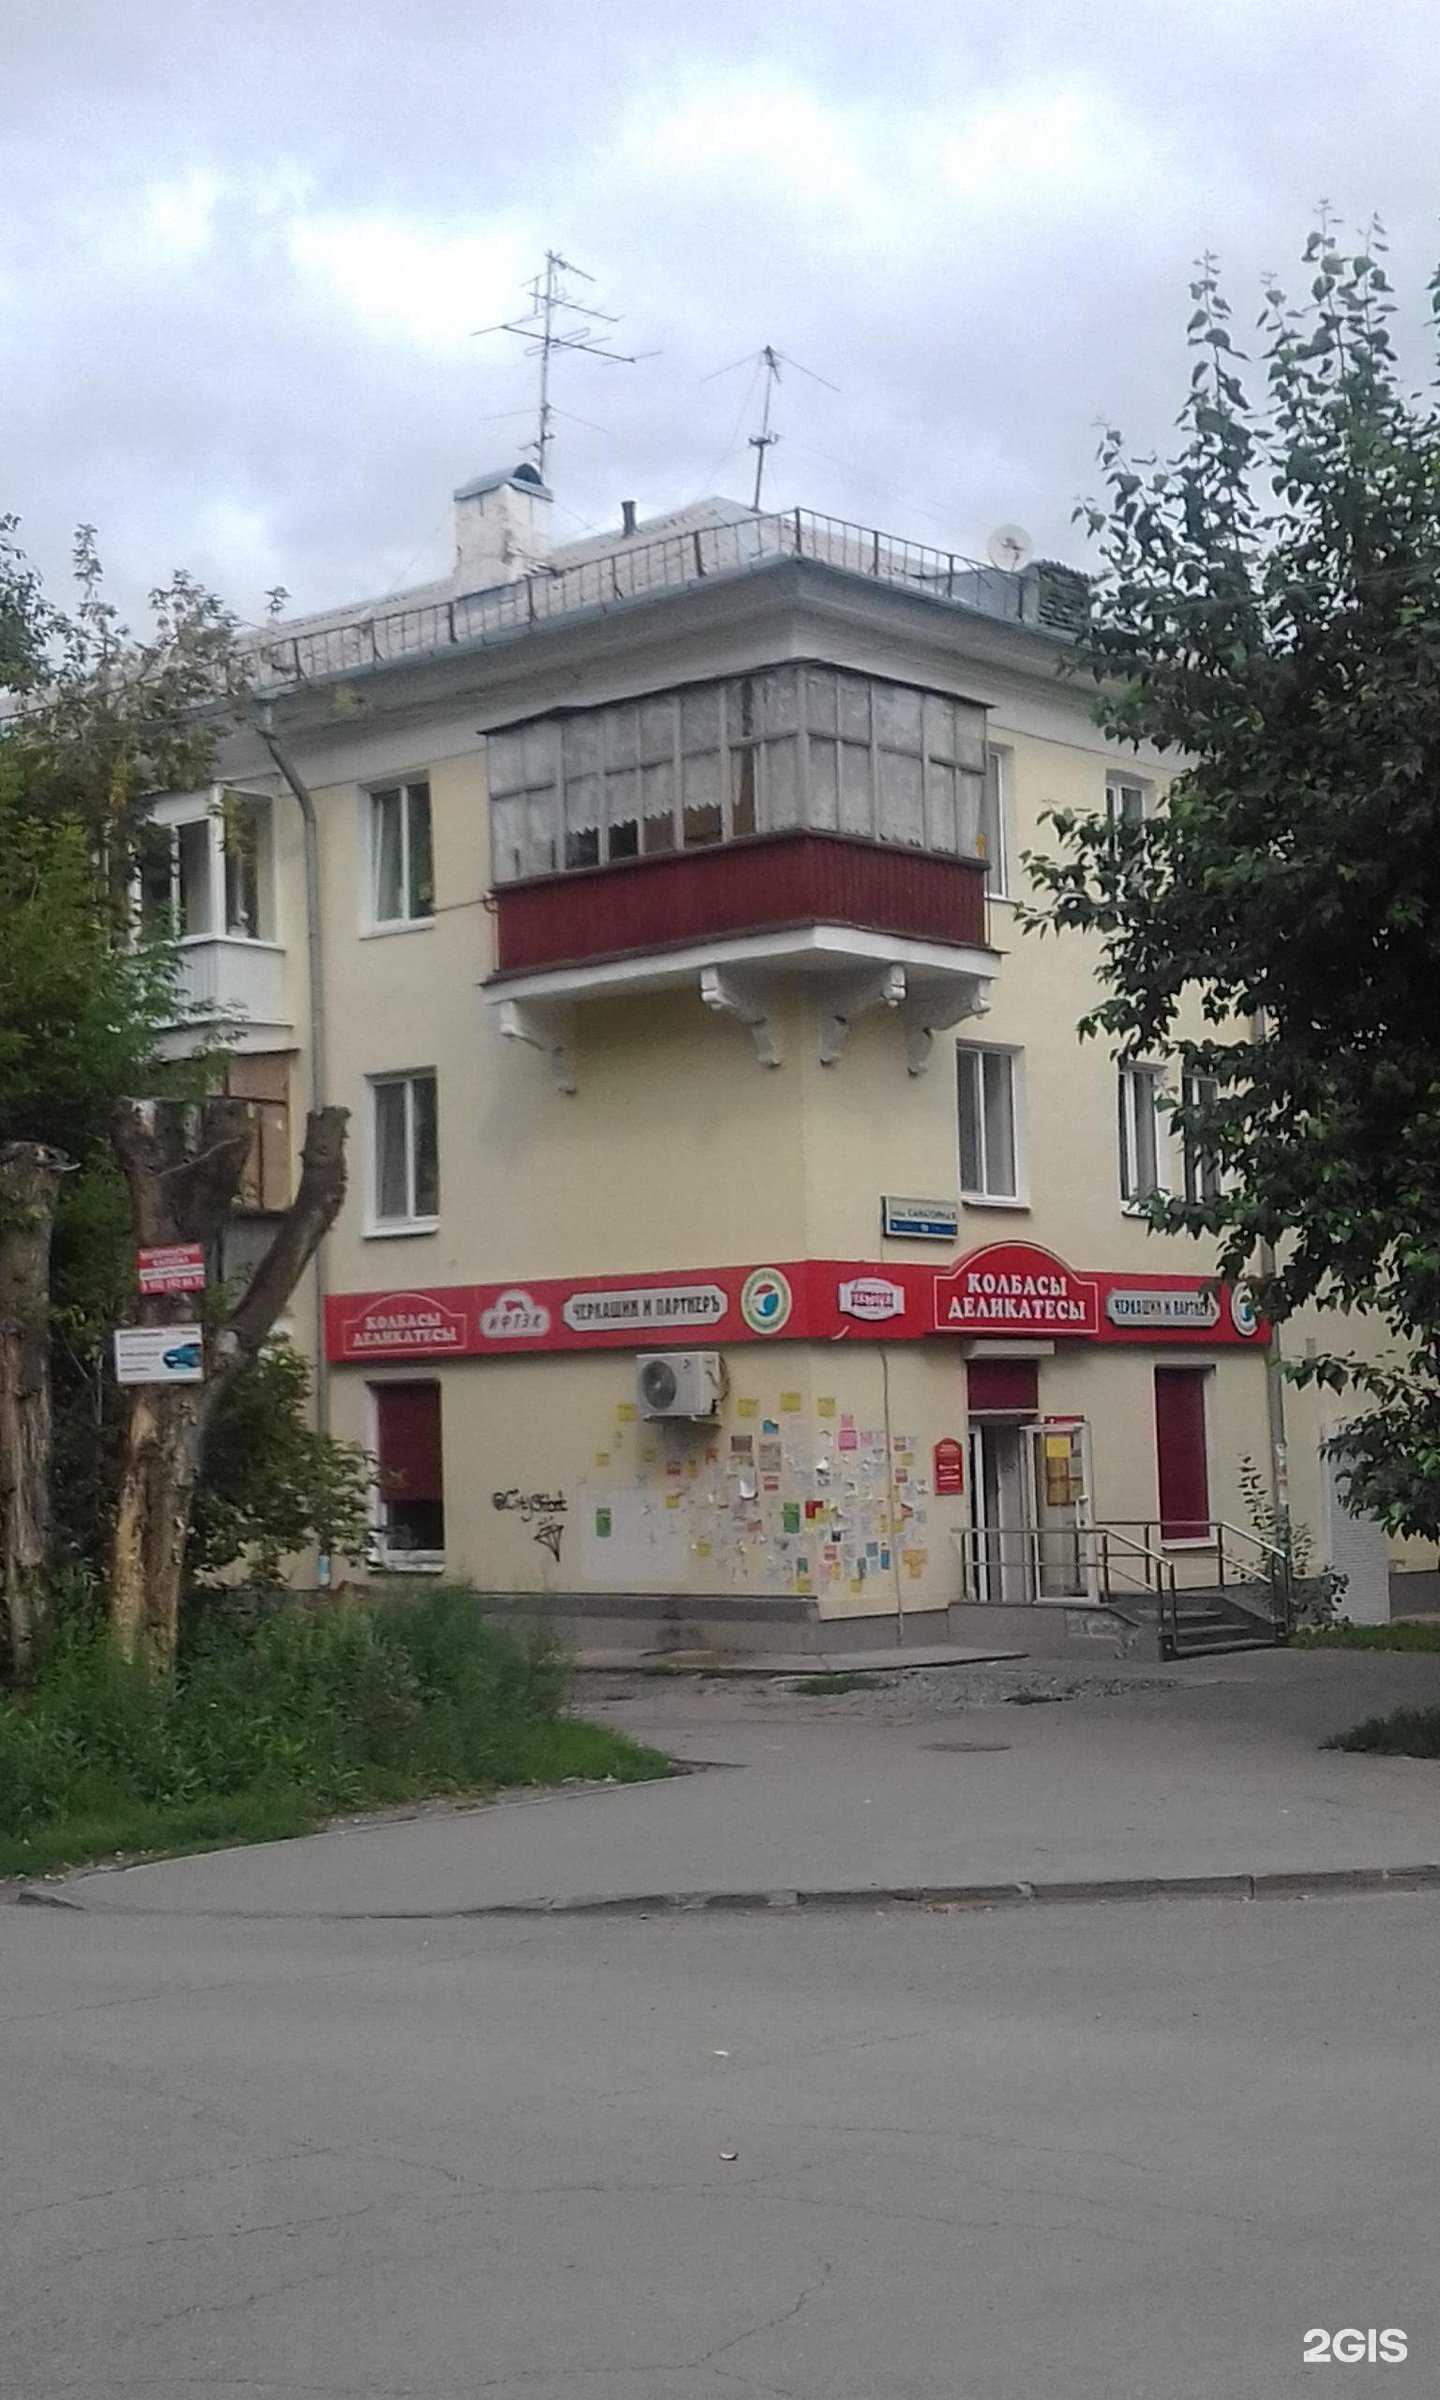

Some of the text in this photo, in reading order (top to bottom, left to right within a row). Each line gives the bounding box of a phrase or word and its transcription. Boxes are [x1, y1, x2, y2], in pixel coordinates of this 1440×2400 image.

[967, 1273, 1068, 1297] КОЛБАСЫ
[948, 1296, 1086, 1321] ДЕЛИКАТЕСЫ
[364, 1312, 441, 1331] КОЛБАСЫ
[353, 1326, 457, 1347] ДЕЛИКАТЕСЫ
